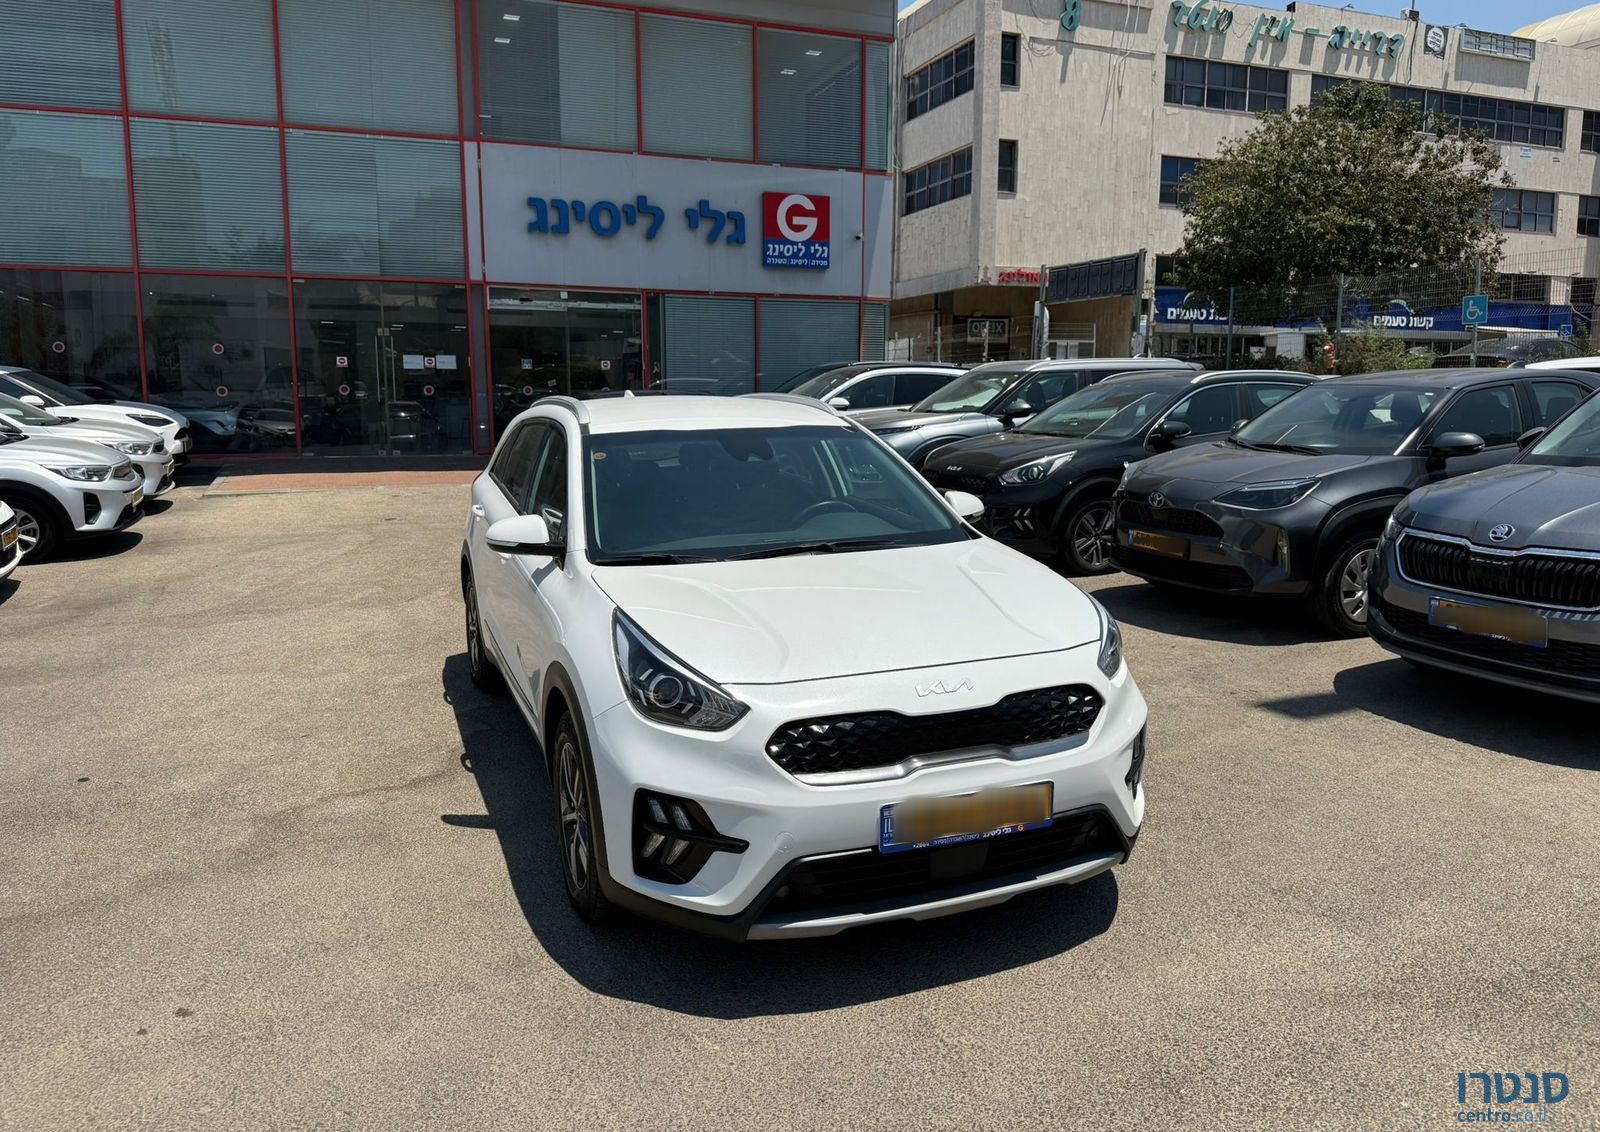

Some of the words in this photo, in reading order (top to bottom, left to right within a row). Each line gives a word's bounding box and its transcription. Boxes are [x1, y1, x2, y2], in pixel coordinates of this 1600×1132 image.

[527, 195, 665, 240] ליסינג
[685, 200, 746, 245] גלי
[777, 194, 818, 242] G
[766, 242, 805, 257] ליסינג
[810, 243, 828, 258] גלי
